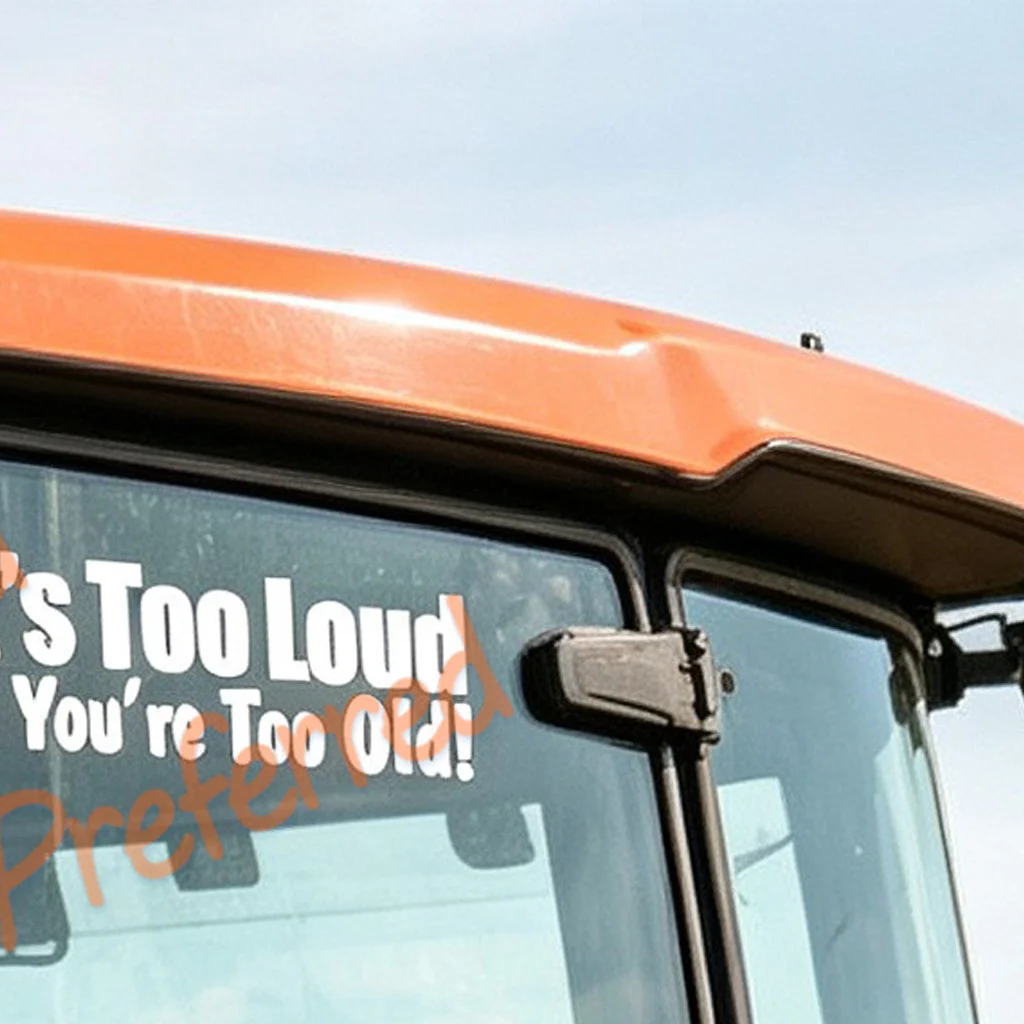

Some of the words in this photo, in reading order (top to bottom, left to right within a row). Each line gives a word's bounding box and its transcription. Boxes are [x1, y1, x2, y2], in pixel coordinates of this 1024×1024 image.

[85, 559, 250, 679] Too
[264, 577, 469, 696] Loud
[11, 674, 207, 760] You're
[219, 688, 326, 768] Too
[342, 693, 475, 782] Old!
